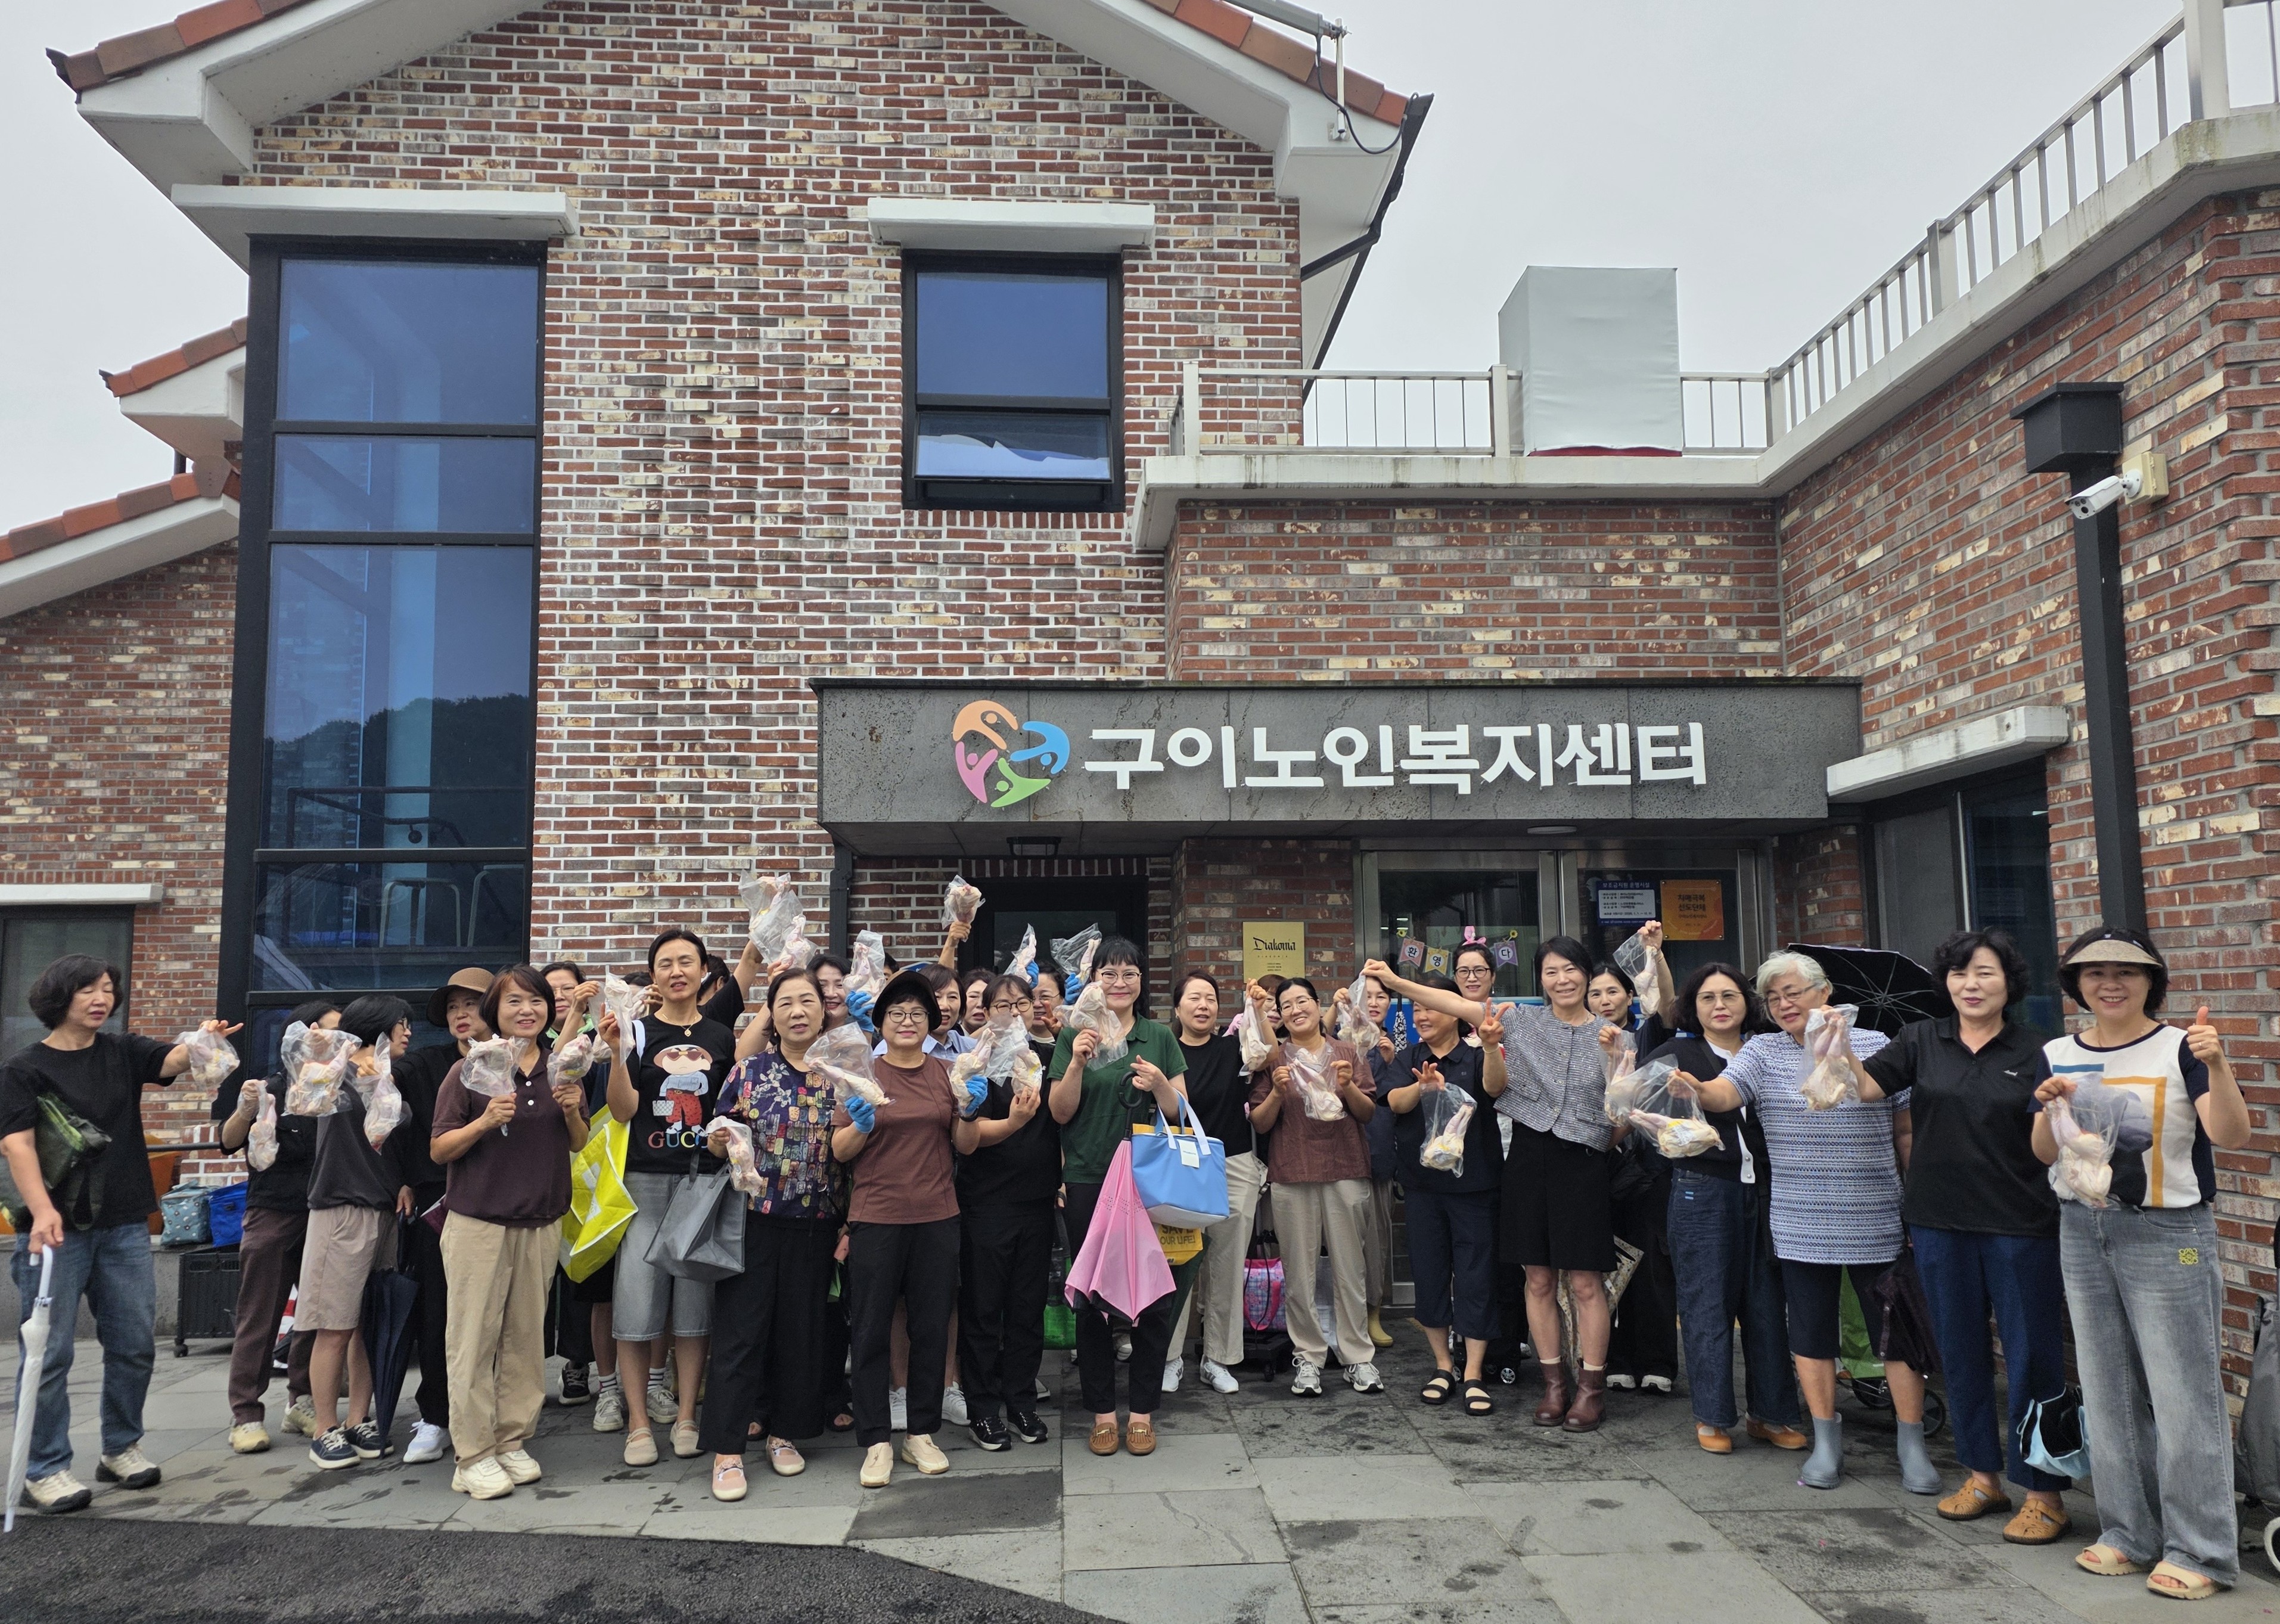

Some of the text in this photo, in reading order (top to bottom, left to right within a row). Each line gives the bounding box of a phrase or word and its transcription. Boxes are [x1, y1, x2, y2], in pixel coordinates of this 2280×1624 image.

[1083, 722, 1707, 794] 구이노인복지센터
[1252, 936, 1296, 951] Diakonia
[1160, 1235, 1176, 1245] OUR
